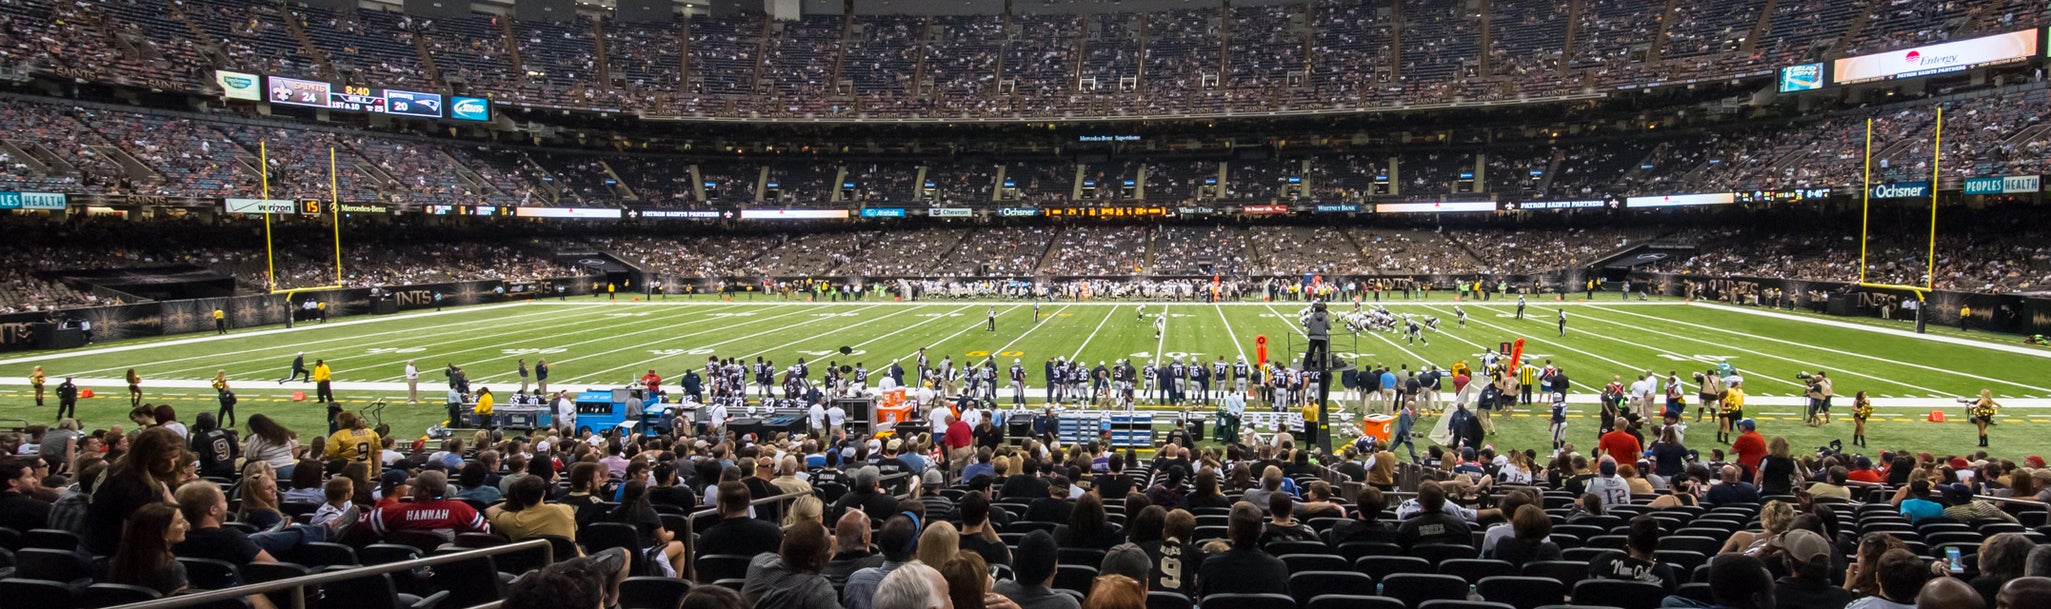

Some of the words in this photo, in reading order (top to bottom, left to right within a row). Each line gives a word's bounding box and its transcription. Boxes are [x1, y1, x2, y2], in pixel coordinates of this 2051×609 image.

[1920, 55, 1958, 66] Entergy
[294, 82, 326, 92] SAINTS
[345, 86, 370, 96] 8:40
[302, 92, 316, 102] 24
[394, 102, 408, 111] 20
[1966, 180, 2001, 192] PEOPLES
[2005, 178, 2038, 190] HEALTH
[1876, 184, 1923, 198] Ochsner
[24, 194, 64, 206] HEALTH
[127, 194, 166, 205] SAINTS
[306, 201, 318, 212] 15
[341, 204, 386, 213] Mercedes-Benz
[1004, 208, 1035, 216] Ochsner
[1078, 372, 1088, 380] 35
[1236, 367, 1246, 376] 44
[1274, 376, 1286, 384] 77
[1384, 423, 1390, 434] G
[213, 438, 230, 462] 9
[358, 442, 370, 462] 9
[1604, 489, 1628, 504] 12
[406, 509, 450, 520] HANNAH
[1160, 556, 1182, 589] 9
